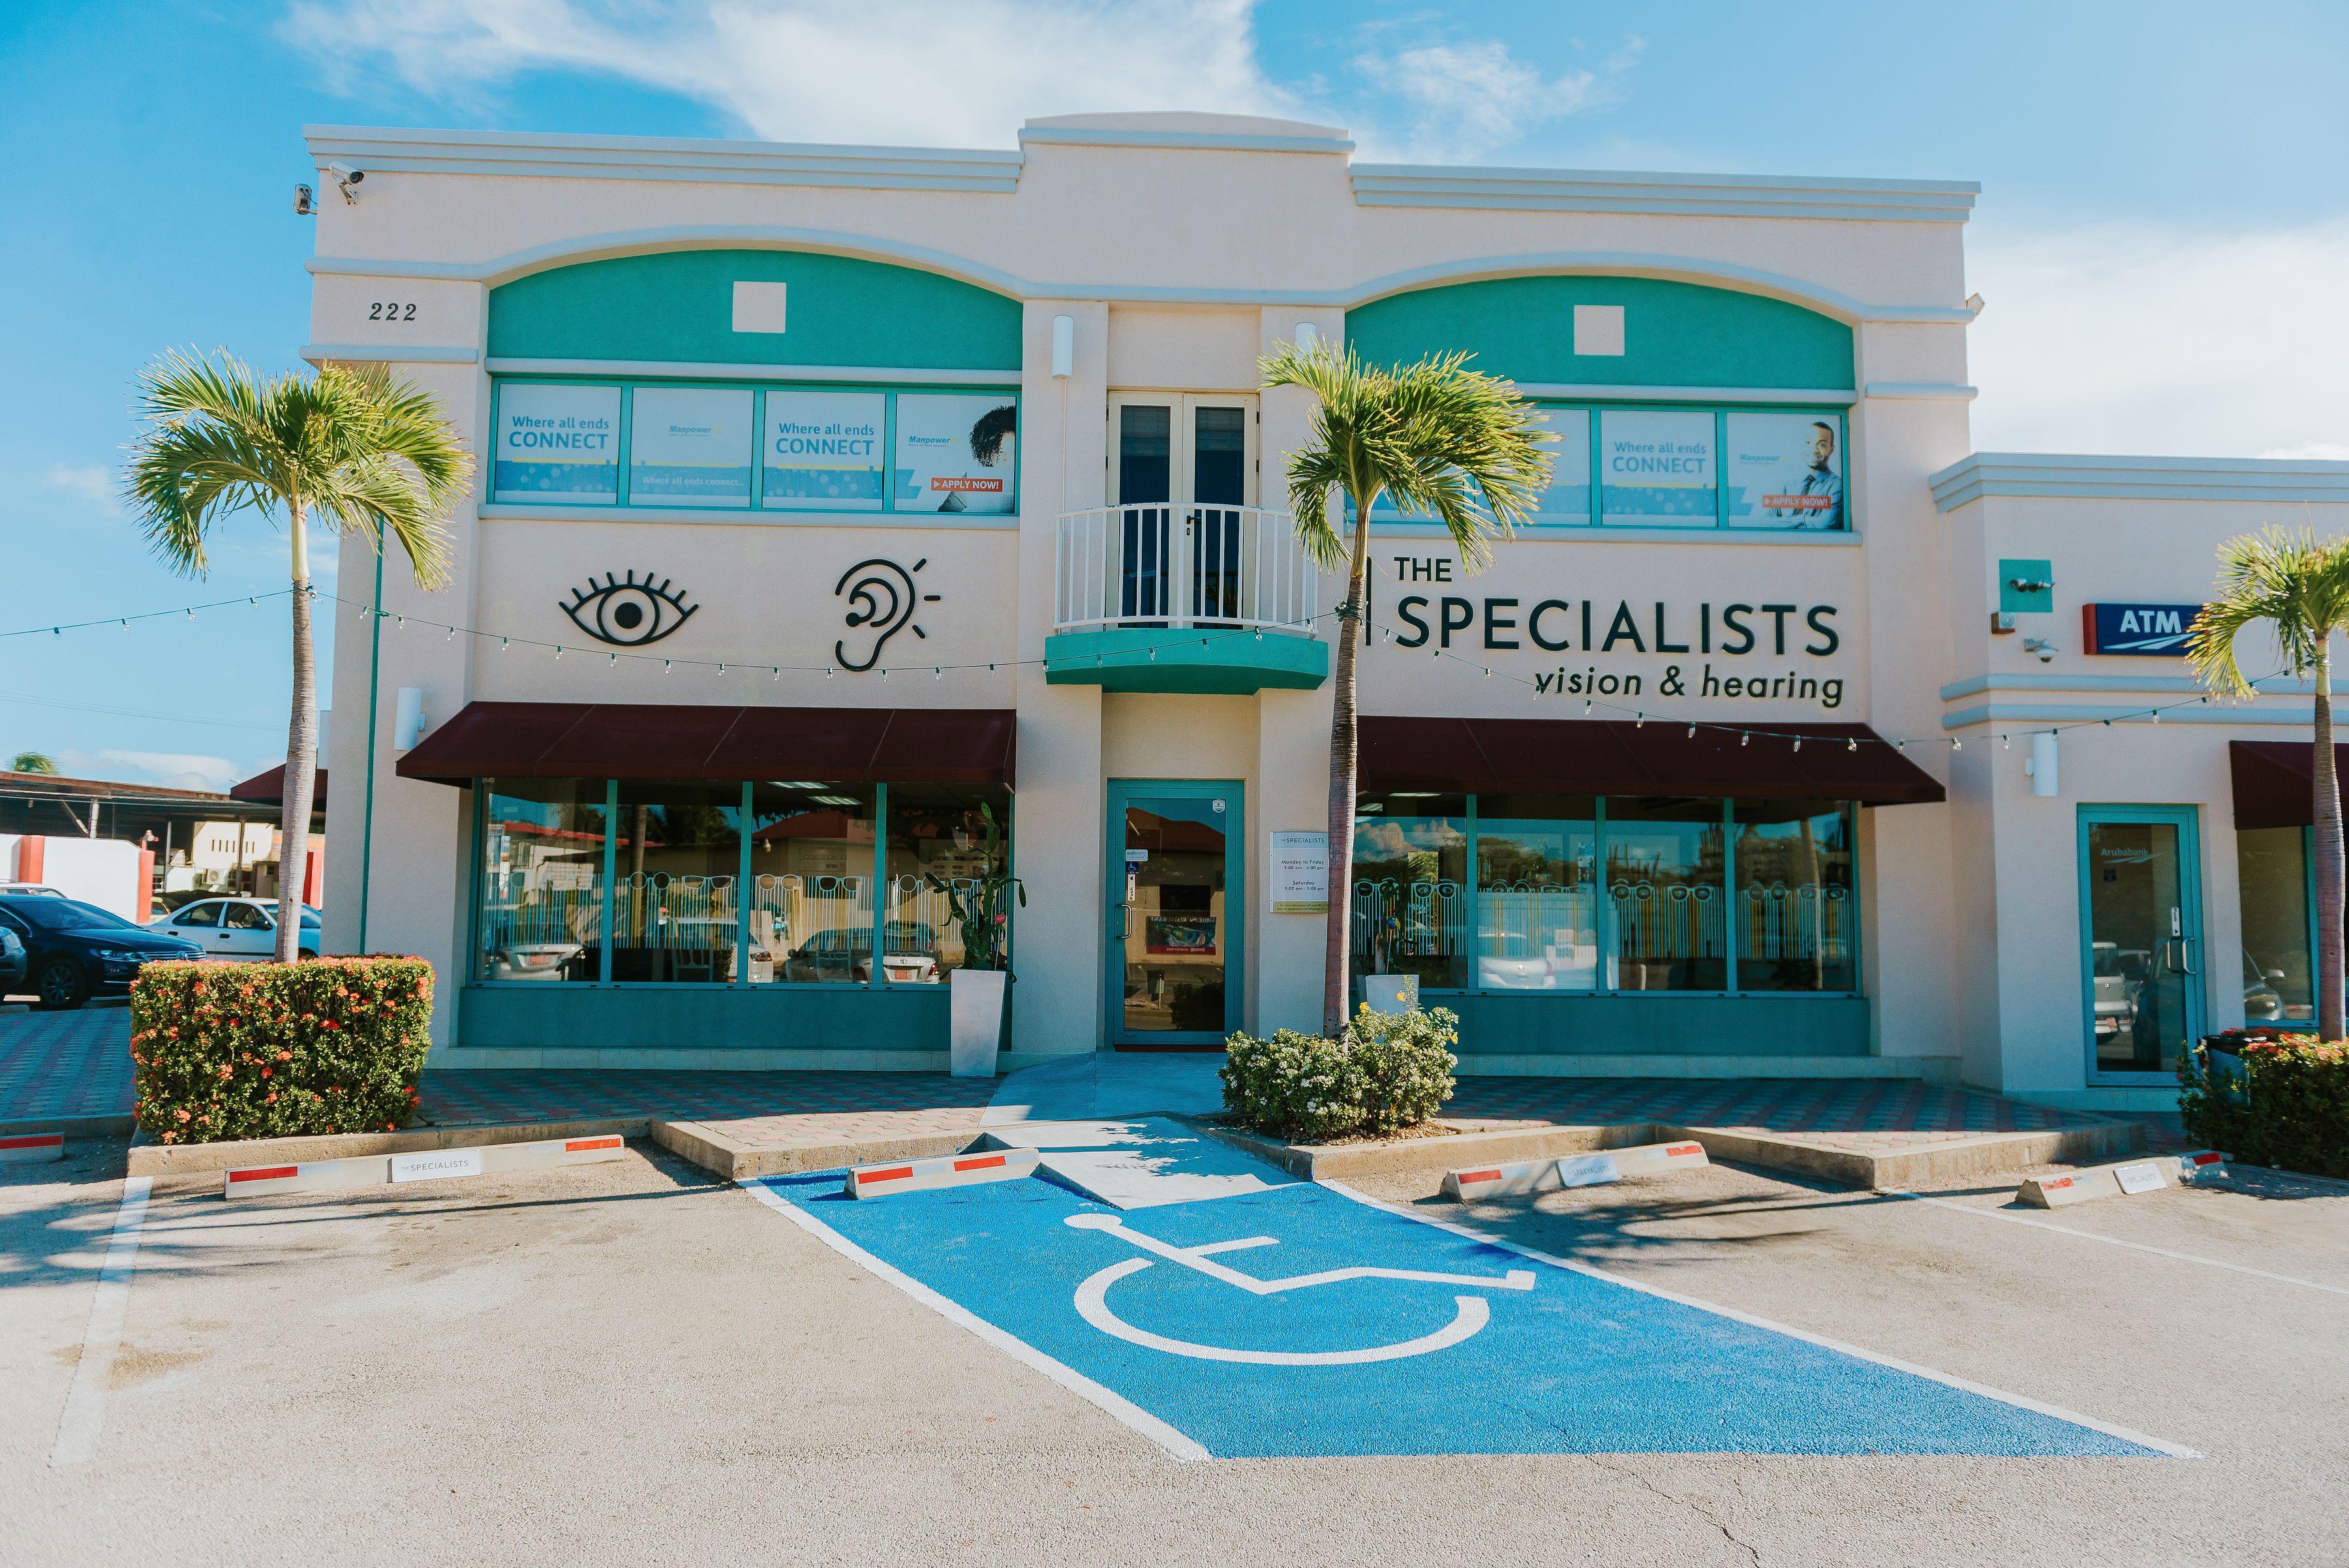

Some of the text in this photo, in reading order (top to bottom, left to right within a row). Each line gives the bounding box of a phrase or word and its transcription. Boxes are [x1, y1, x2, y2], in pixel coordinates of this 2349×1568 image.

[369, 302, 417, 322] 222
[512, 416, 609, 429] Where all ends
[778, 423, 874, 436] Where all ends
[509, 431, 609, 449] CONNECT
[776, 438, 874, 455] CONNECT
[1614, 441, 1707, 454] Where all ends
[1612, 456, 1706, 473] CONNECT
[942, 480, 999, 489] APPLY NOW!
[1773, 497, 1828, 506] APPLY NOW!
[1394, 556, 1452, 583] THE
[1395, 595, 1840, 657] SPECIALISTS
[2120, 609, 2182, 634] ATM
[1535, 664, 1844, 709] vision & hearing
[410, 1160, 469, 1171] SPECIALISTS
